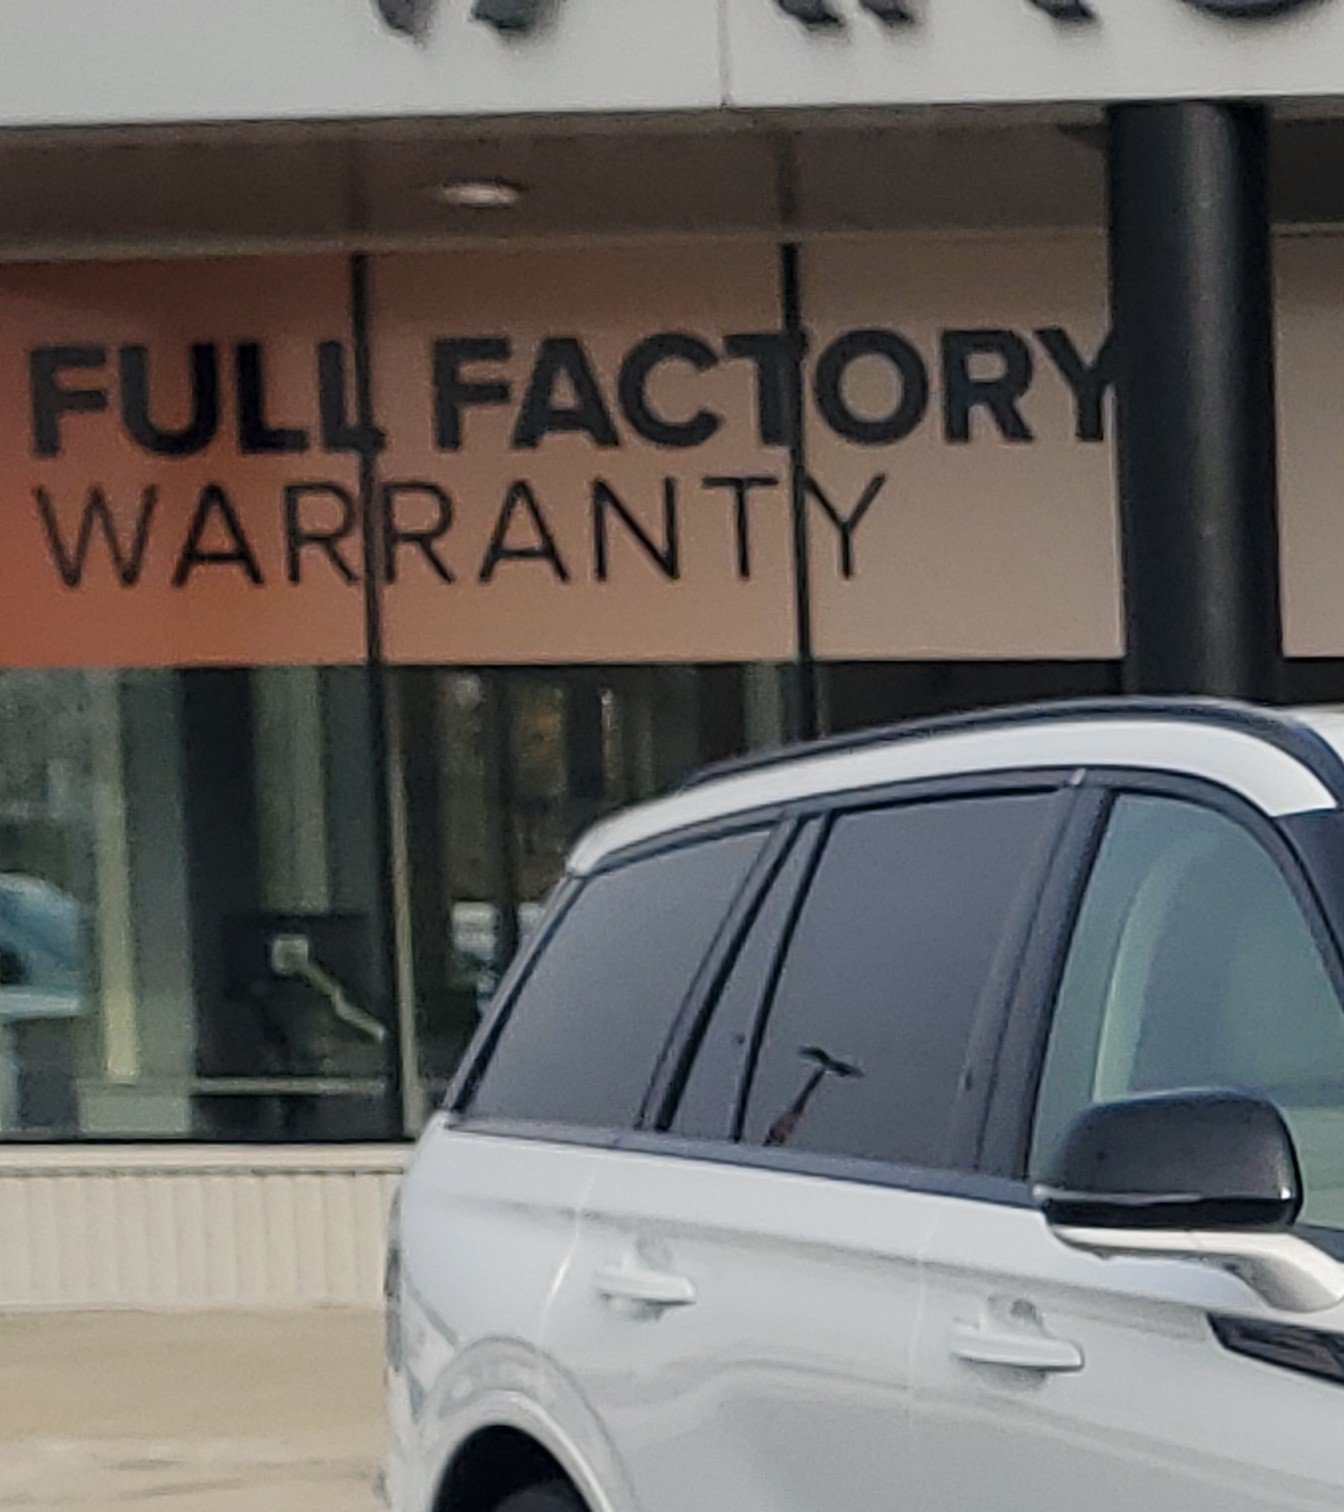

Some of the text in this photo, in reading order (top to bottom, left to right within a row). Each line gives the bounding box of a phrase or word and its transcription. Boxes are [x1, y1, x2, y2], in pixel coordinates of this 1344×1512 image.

[29, 326, 1114, 455] FULL FACTORY
[32, 475, 886, 588] WARRANTY
